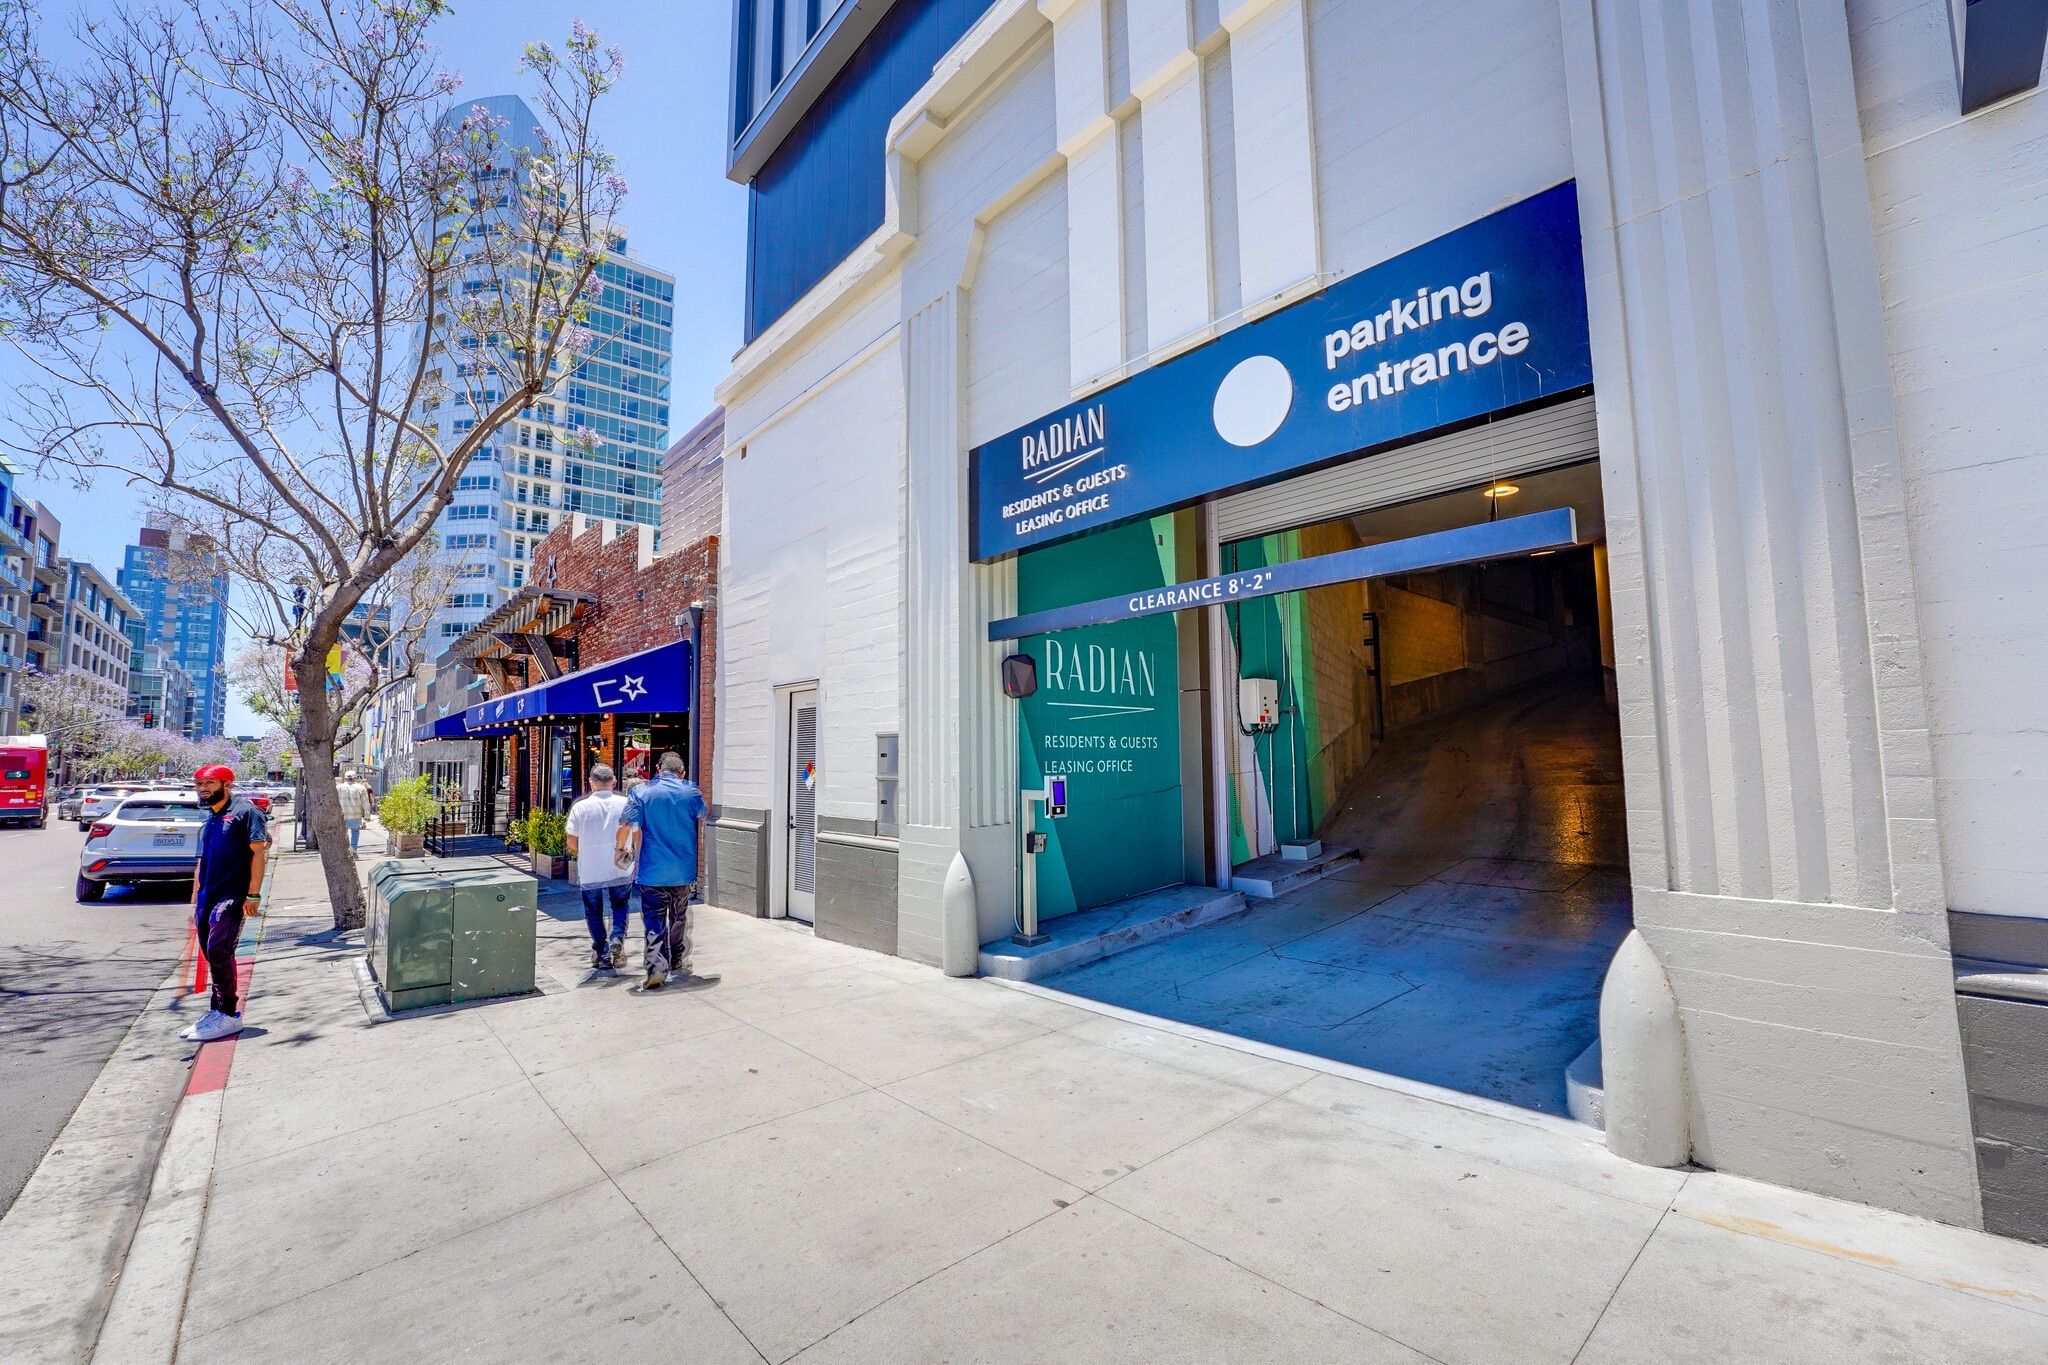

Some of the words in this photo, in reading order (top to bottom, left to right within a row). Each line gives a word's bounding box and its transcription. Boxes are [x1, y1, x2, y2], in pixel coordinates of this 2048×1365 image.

[1325, 271, 1492, 370] parking
[1327, 321, 1530, 411] entrance
[1022, 404, 1104, 470] RADIAN
[1002, 487, 1060, 518] RESIDENTS
[1062, 483, 1074, 498] &
[1076, 464, 1126, 492] GUESTS
[1016, 509, 1063, 535] LEASING
[1065, 494, 1110, 519] OFFICE
[1129, 582, 1222, 612] CLEARANCE
[1228, 572, 1272, 594] 8'-2"
[1046, 639, 1155, 697] RADIAN
[1044, 735, 1105, 749] RESIDENTS
[1109, 736, 1117, 749] &
[1120, 736, 1158, 749] GUESTS
[1044, 760, 1094, 773] LEASING
[1097, 759, 1133, 772] OFFICE
